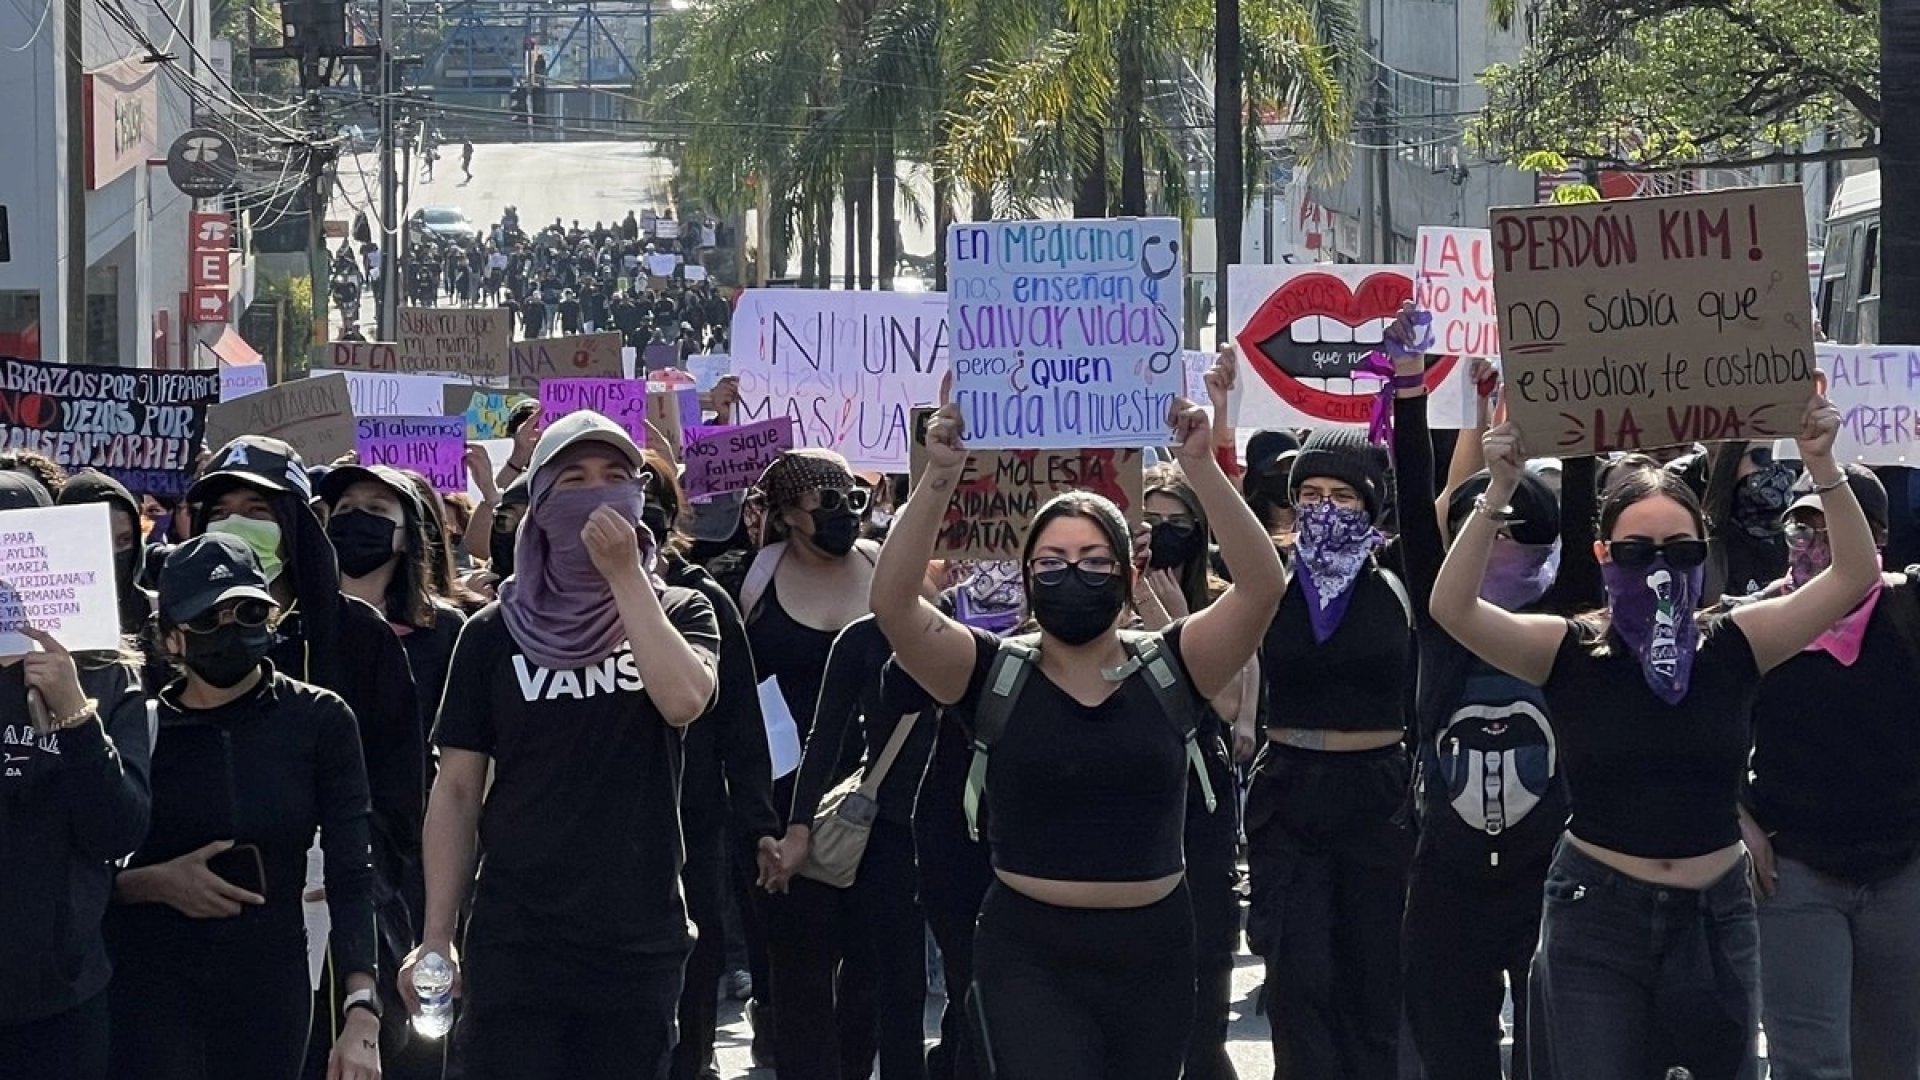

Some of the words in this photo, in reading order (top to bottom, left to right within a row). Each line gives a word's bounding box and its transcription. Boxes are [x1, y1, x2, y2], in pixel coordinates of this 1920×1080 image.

[956, 228, 989, 265] En
[1004, 224, 1134, 269] Medicina
[1421, 234, 1464, 278] LA
[1497, 206, 1637, 272] PERDÓN
[203, 256, 221, 280] E
[954, 276, 1000, 301] nos
[1013, 272, 1133, 303] enseñan
[1273, 281, 1336, 322] SOMOS
[1417, 286, 1450, 313] NO
[1078, 302, 1166, 347] vidas
[1509, 300, 1560, 341] no
[1699, 287, 1759, 333] que
[335, 344, 362, 366] DE
[1662, 353, 1689, 393] te
[1705, 346, 1811, 387] costaba
[546, 383, 575, 403] HOY
[577, 385, 607, 413] NO
[608, 383, 625, 401] ES
[956, 390, 1044, 440] cuida
[1054, 386, 1082, 435] la
[141, 406, 195, 439] POR
[358, 418, 387, 439] Sin
[388, 416, 462, 438] alumnos
[1594, 407, 1644, 451] LA
[1667, 403, 1746, 442] VIDA
[370, 444, 400, 465] NO
[407, 441, 439, 465] HAY
[729, 428, 779, 462] sigue
[996, 454, 1105, 486] MOLESTA
[511, 652, 644, 702] VANS
